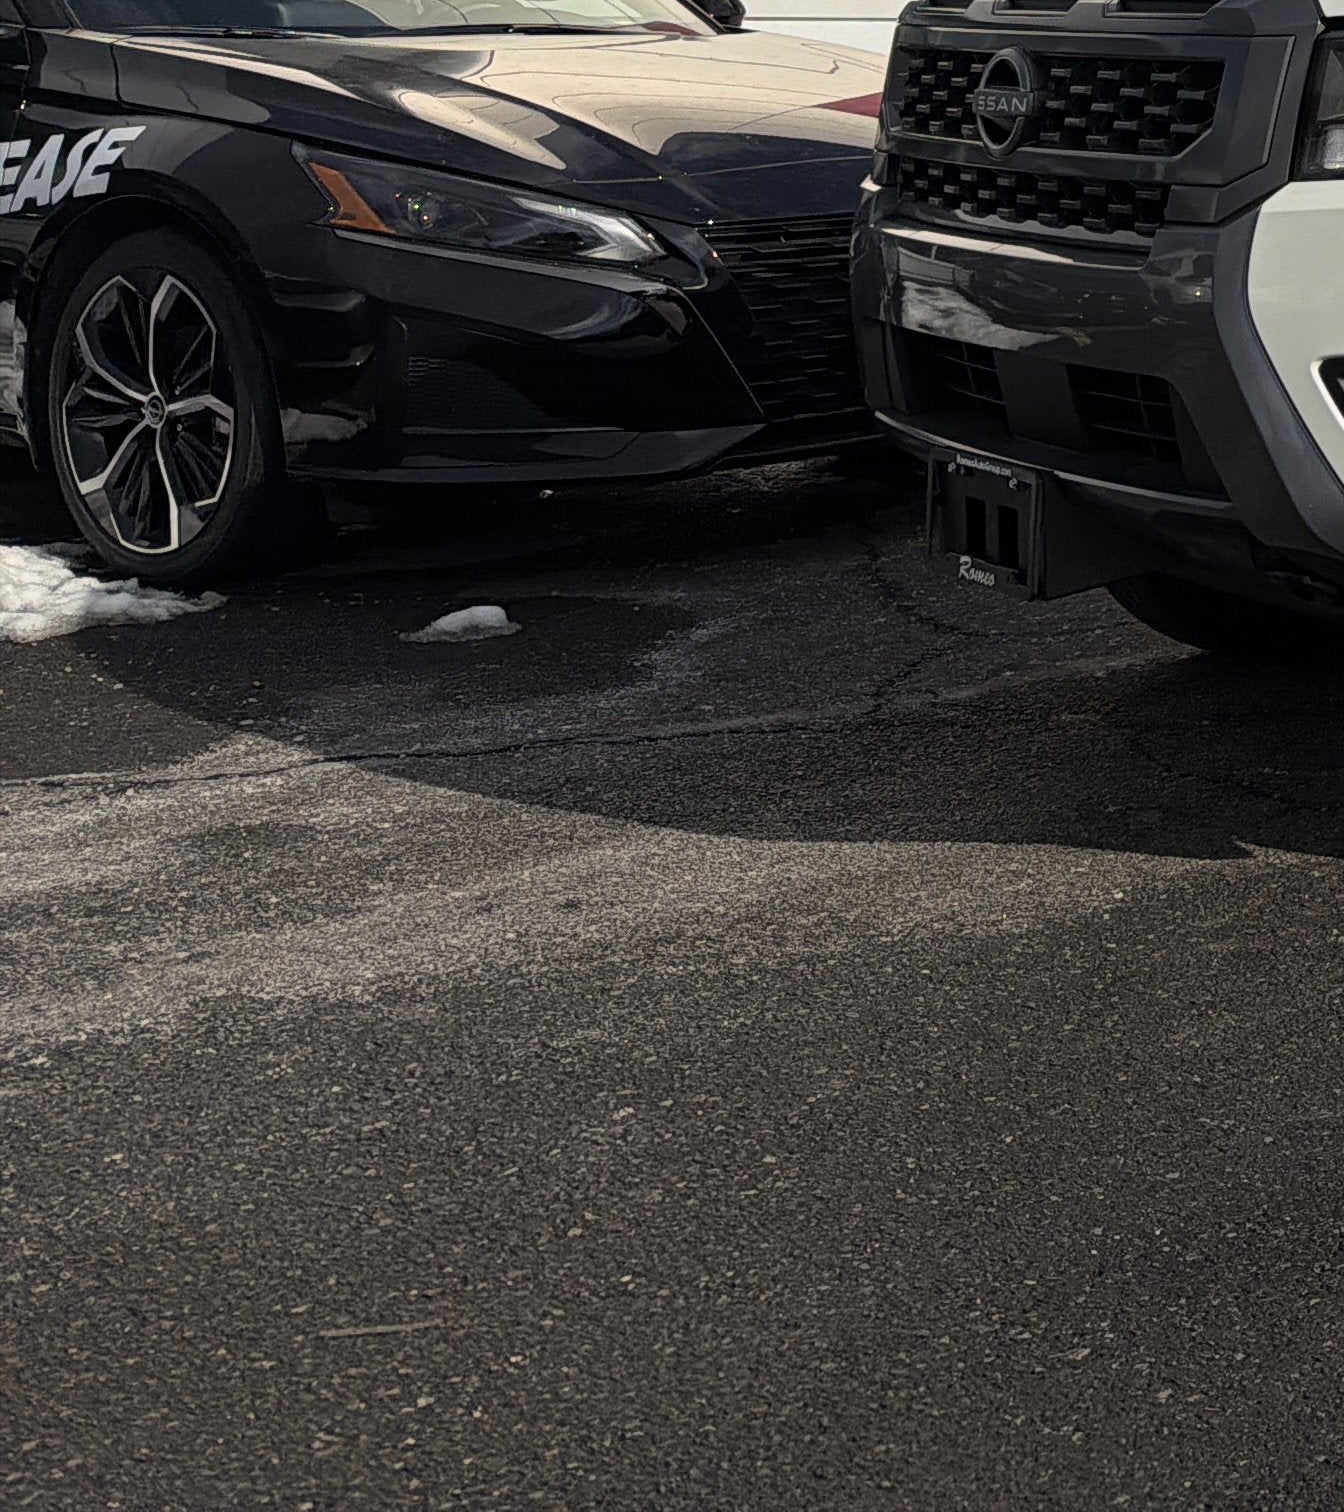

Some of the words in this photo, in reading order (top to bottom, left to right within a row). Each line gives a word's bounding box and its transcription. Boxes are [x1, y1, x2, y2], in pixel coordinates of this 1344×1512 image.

[977, 95, 1027, 112] SSAN
[0, 125, 147, 216] EASE
[958, 555, 995, 586] Romeo
